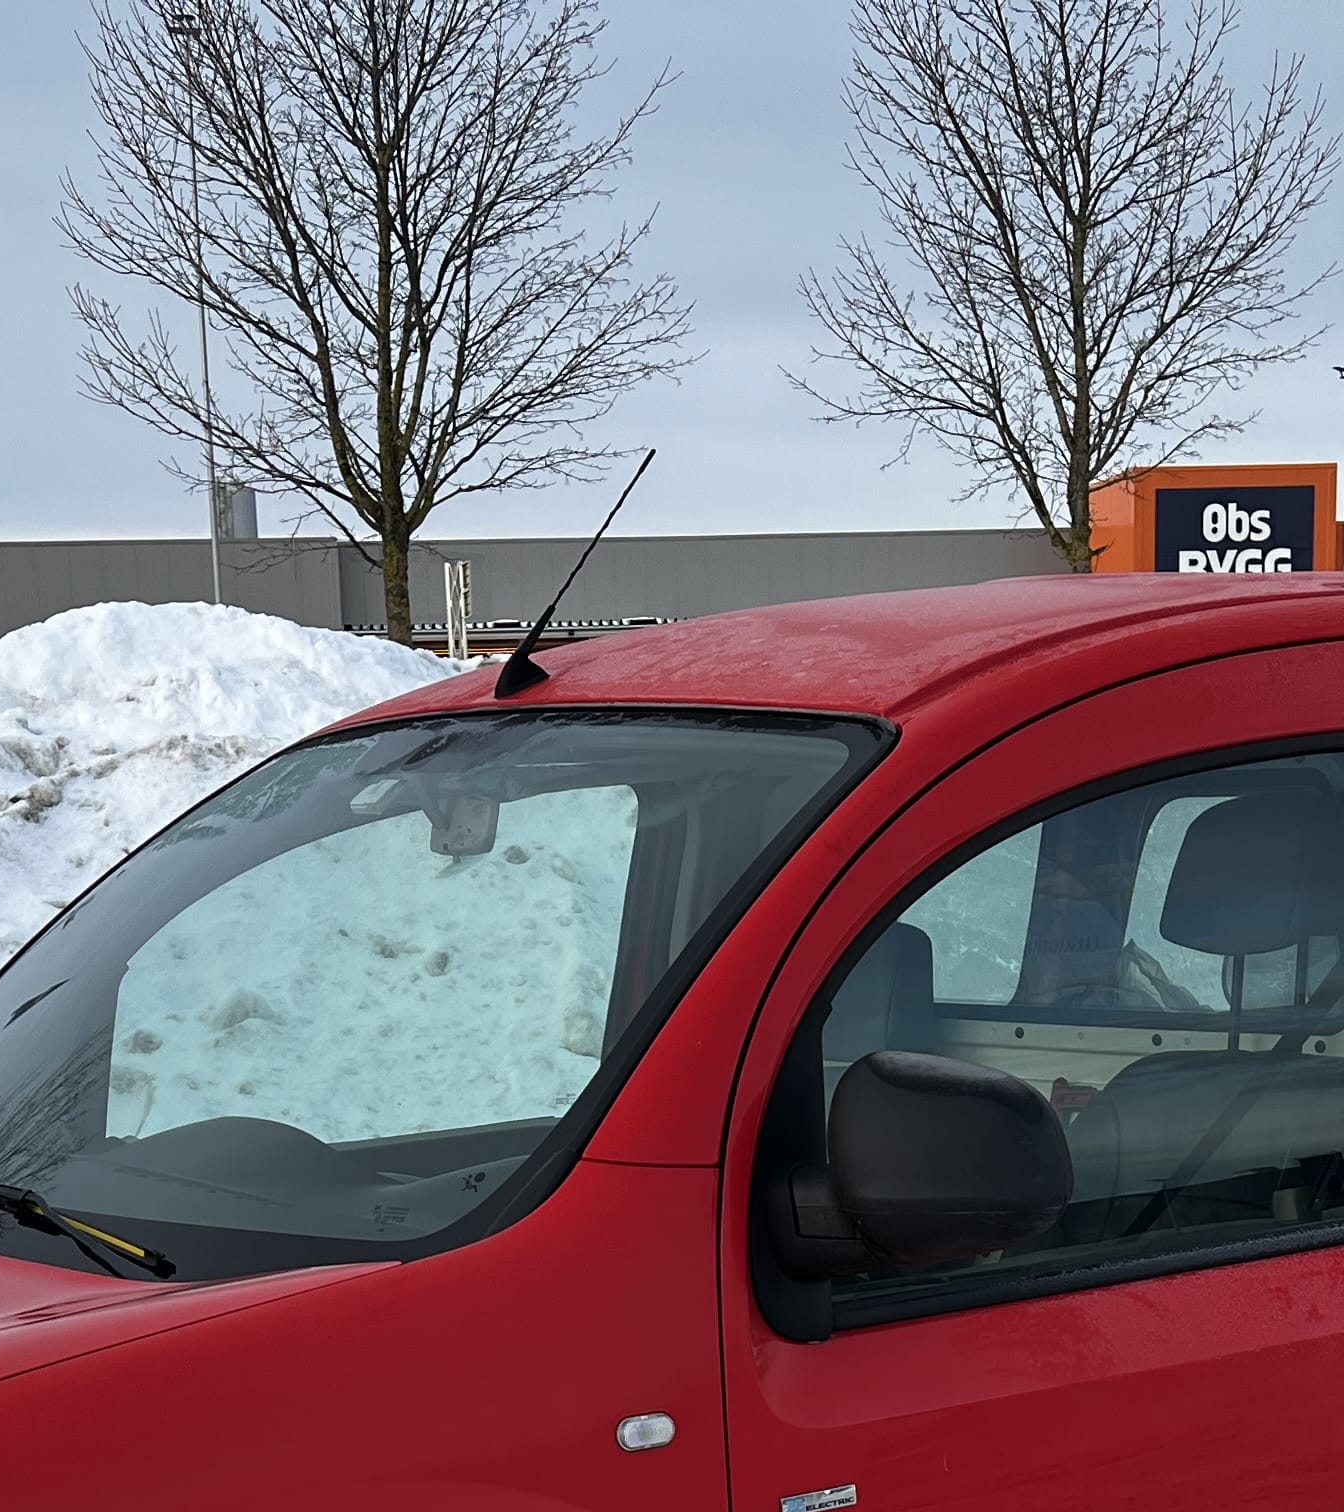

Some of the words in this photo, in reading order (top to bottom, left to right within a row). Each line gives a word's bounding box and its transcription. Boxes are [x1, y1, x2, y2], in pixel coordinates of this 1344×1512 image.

[1202, 502, 1271, 543] Obs
[1178, 548, 1292, 573] BYGG
[805, 1496, 854, 1511] ELECTRIC
